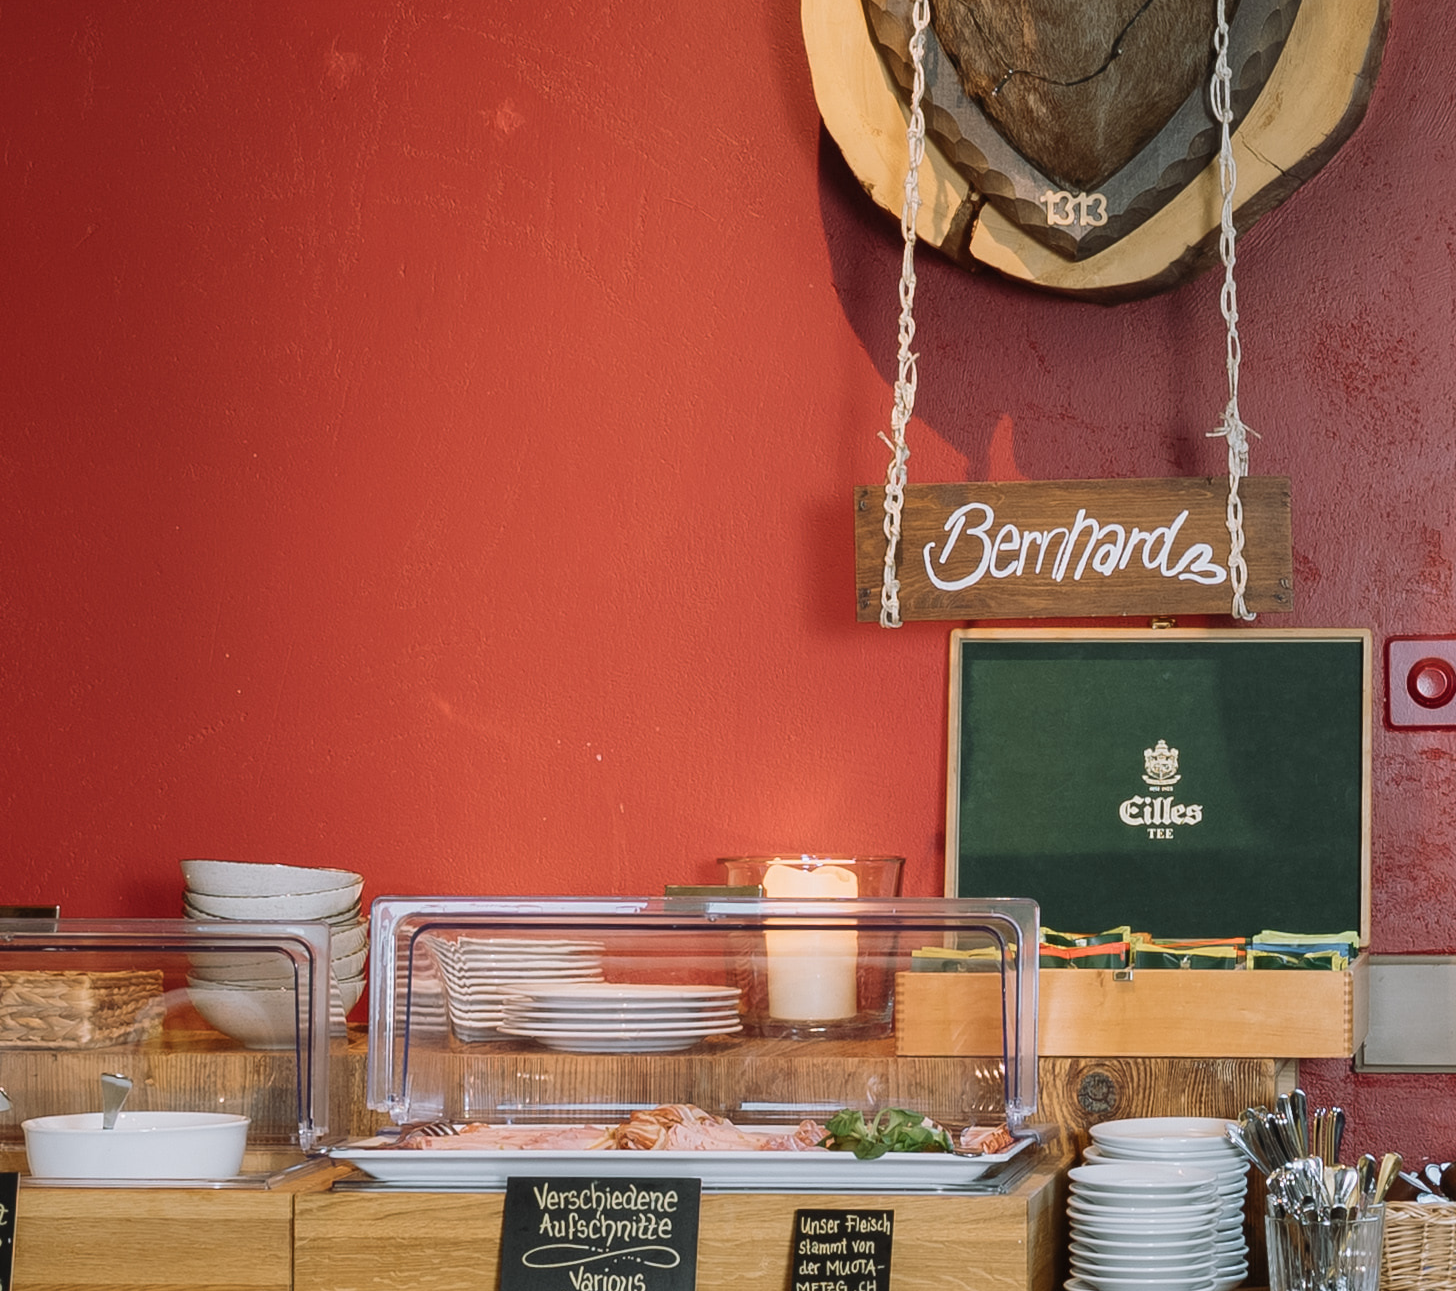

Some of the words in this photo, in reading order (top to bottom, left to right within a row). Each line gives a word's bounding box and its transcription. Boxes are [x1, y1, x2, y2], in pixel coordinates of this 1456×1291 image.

[1040, 189, 1108, 227] 1313
[1119, 794, 1204, 826] Eilles
[1147, 828, 1174, 839] TEE
[533, 1182, 679, 1219] Verschiedene
[538, 1211, 673, 1247] Aufschnitte
[799, 1216, 841, 1236] Unser
[844, 1212, 891, 1236] Fleisch
[798, 1237, 848, 1256] stammt
[851, 1239, 876, 1255] von
[798, 1259, 822, 1276] der
